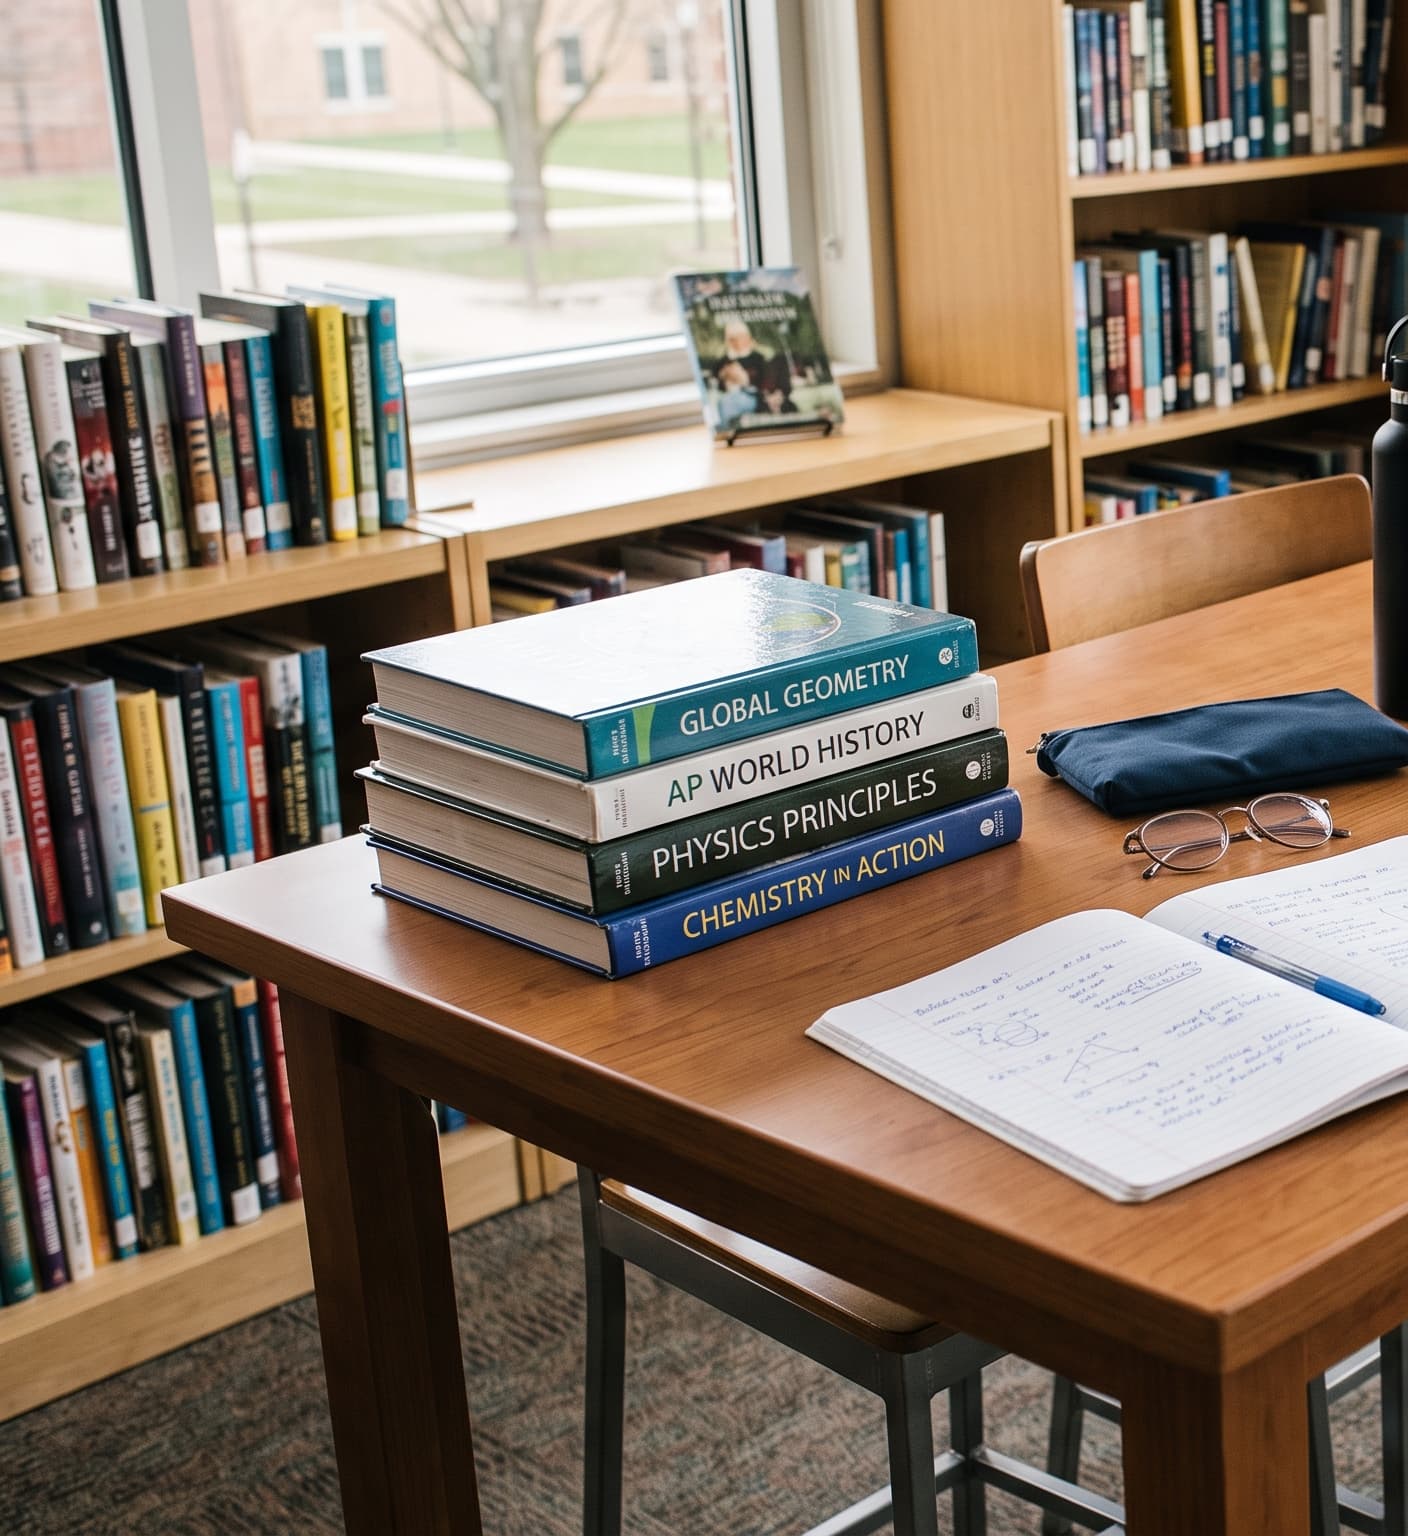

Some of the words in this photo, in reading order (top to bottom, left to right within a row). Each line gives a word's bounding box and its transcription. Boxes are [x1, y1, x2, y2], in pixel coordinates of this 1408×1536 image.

[680, 691, 778, 736] GLOBAL
[783, 654, 910, 708] GEOMETRY
[667, 774, 703, 807] AP
[710, 745, 809, 793] WORLD
[817, 712, 925, 763] HISTORY
[652, 816, 775, 878] PHYSICS
[783, 768, 937, 839] PRINCIPLES
[683, 869, 827, 938] CHEMISTRY
[834, 865, 850, 885] IN
[857, 830, 946, 881] ACTION
